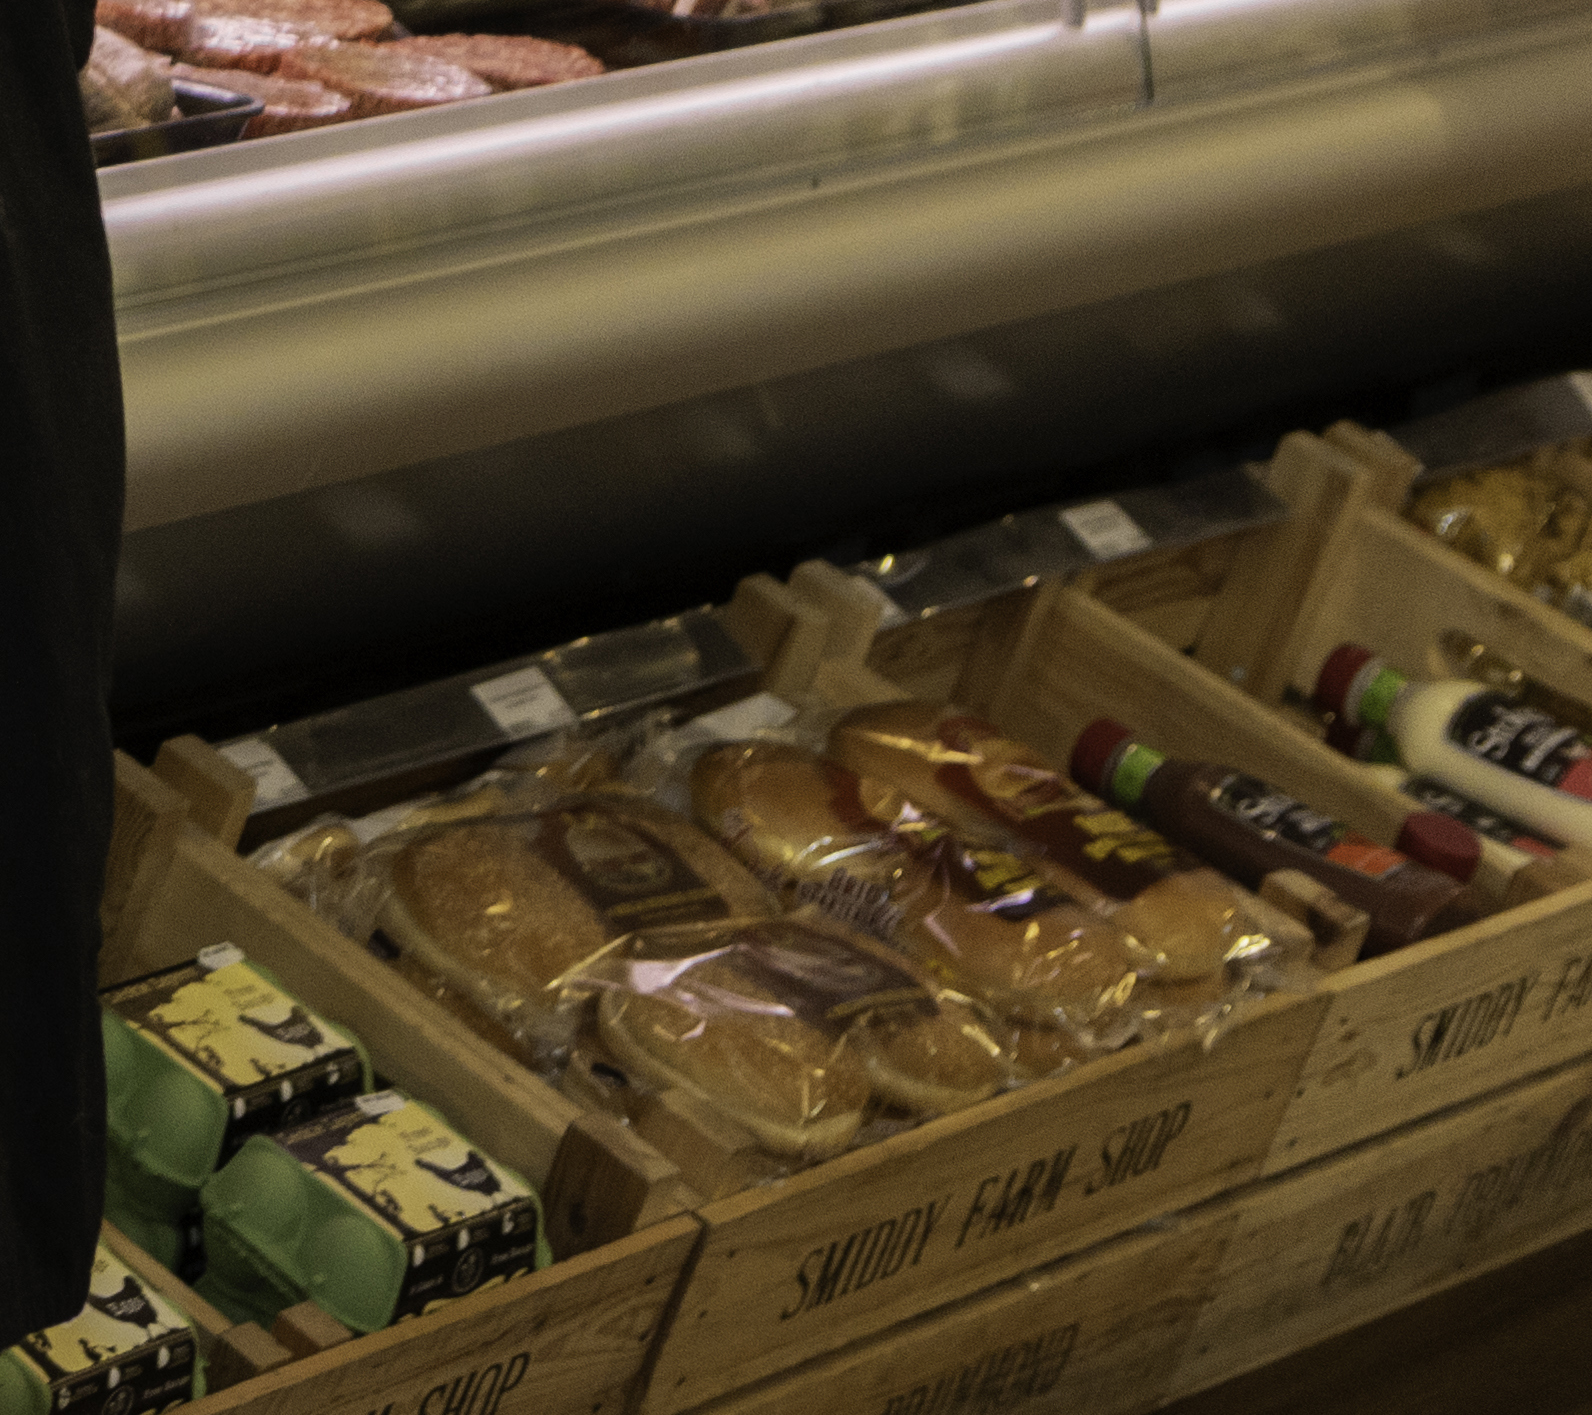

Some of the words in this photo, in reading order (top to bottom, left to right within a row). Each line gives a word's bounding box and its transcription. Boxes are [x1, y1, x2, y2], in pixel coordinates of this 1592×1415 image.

[781, 1192, 951, 1322] SMIDDY
[955, 1143, 1079, 1250] FARM
[1083, 1100, 1193, 1197] SHOP
